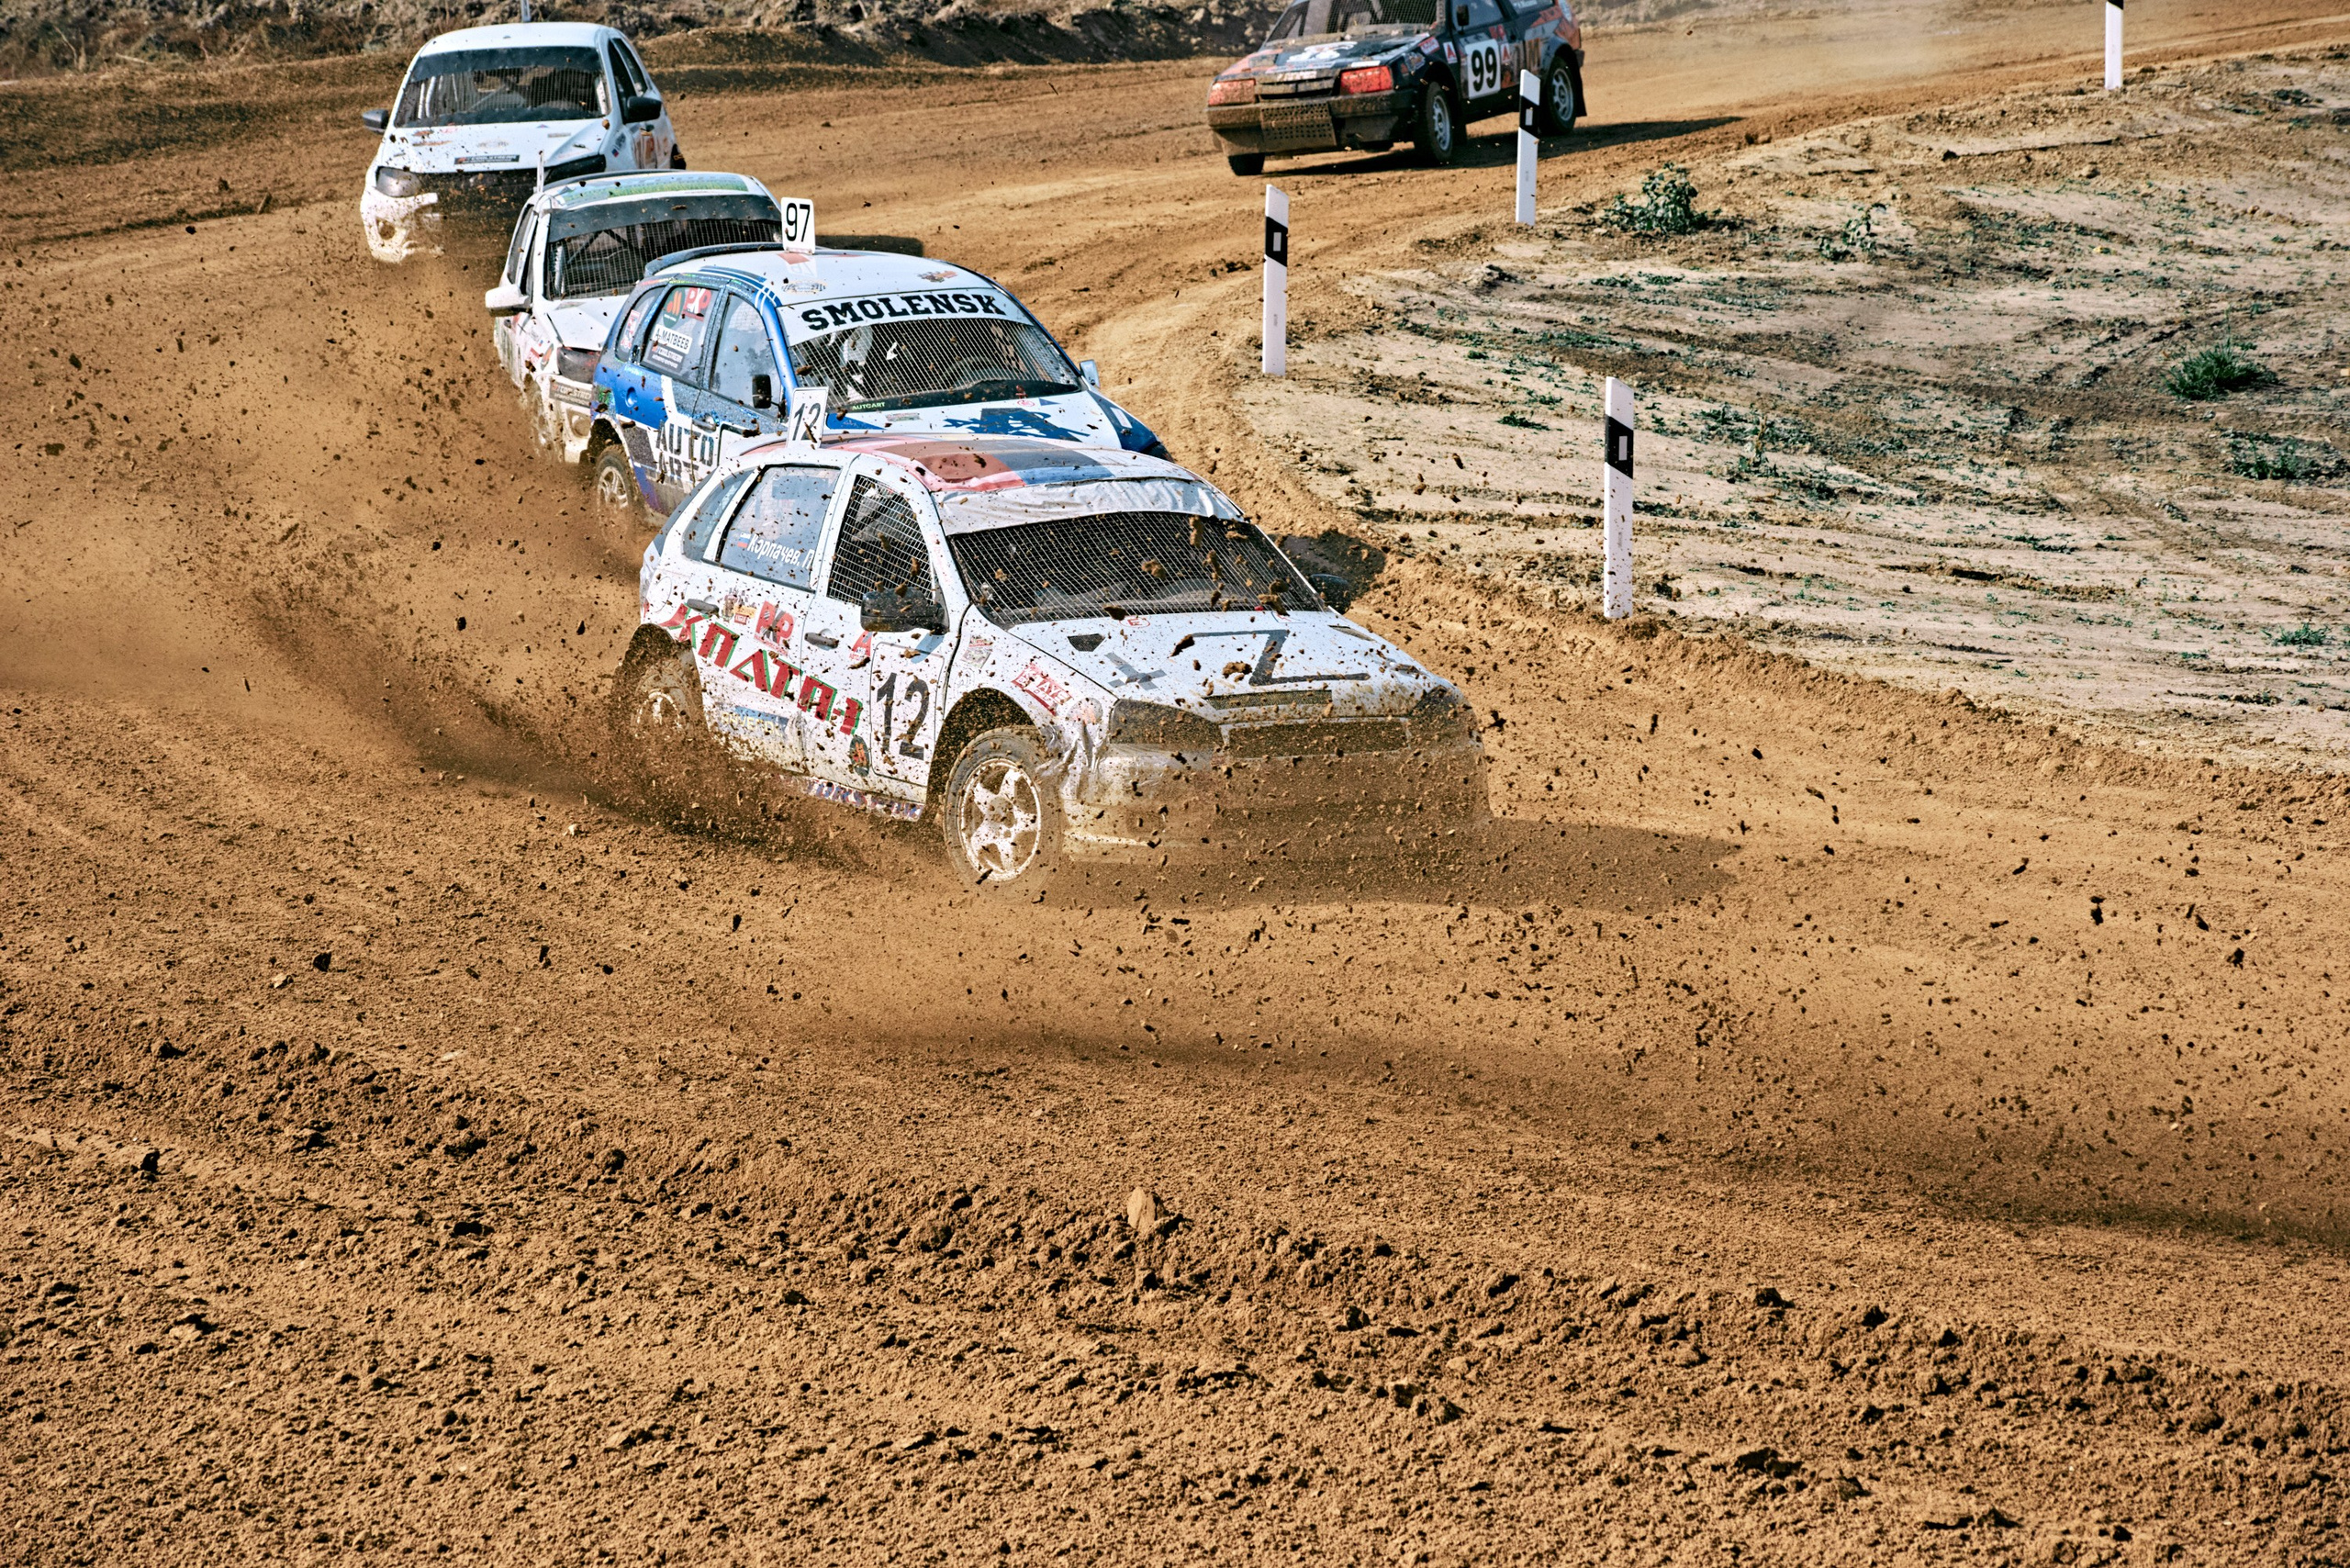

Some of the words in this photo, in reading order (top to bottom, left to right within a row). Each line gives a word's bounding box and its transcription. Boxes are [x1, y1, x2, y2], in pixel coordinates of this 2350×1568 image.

[1472, 47, 1497, 92] 99
[786, 202, 811, 242] 97
[801, 293, 1007, 331] SMOLENSK
[792, 402, 822, 442] 12
[655, 420, 715, 467] AUTO
[877, 672, 930, 761] 12
